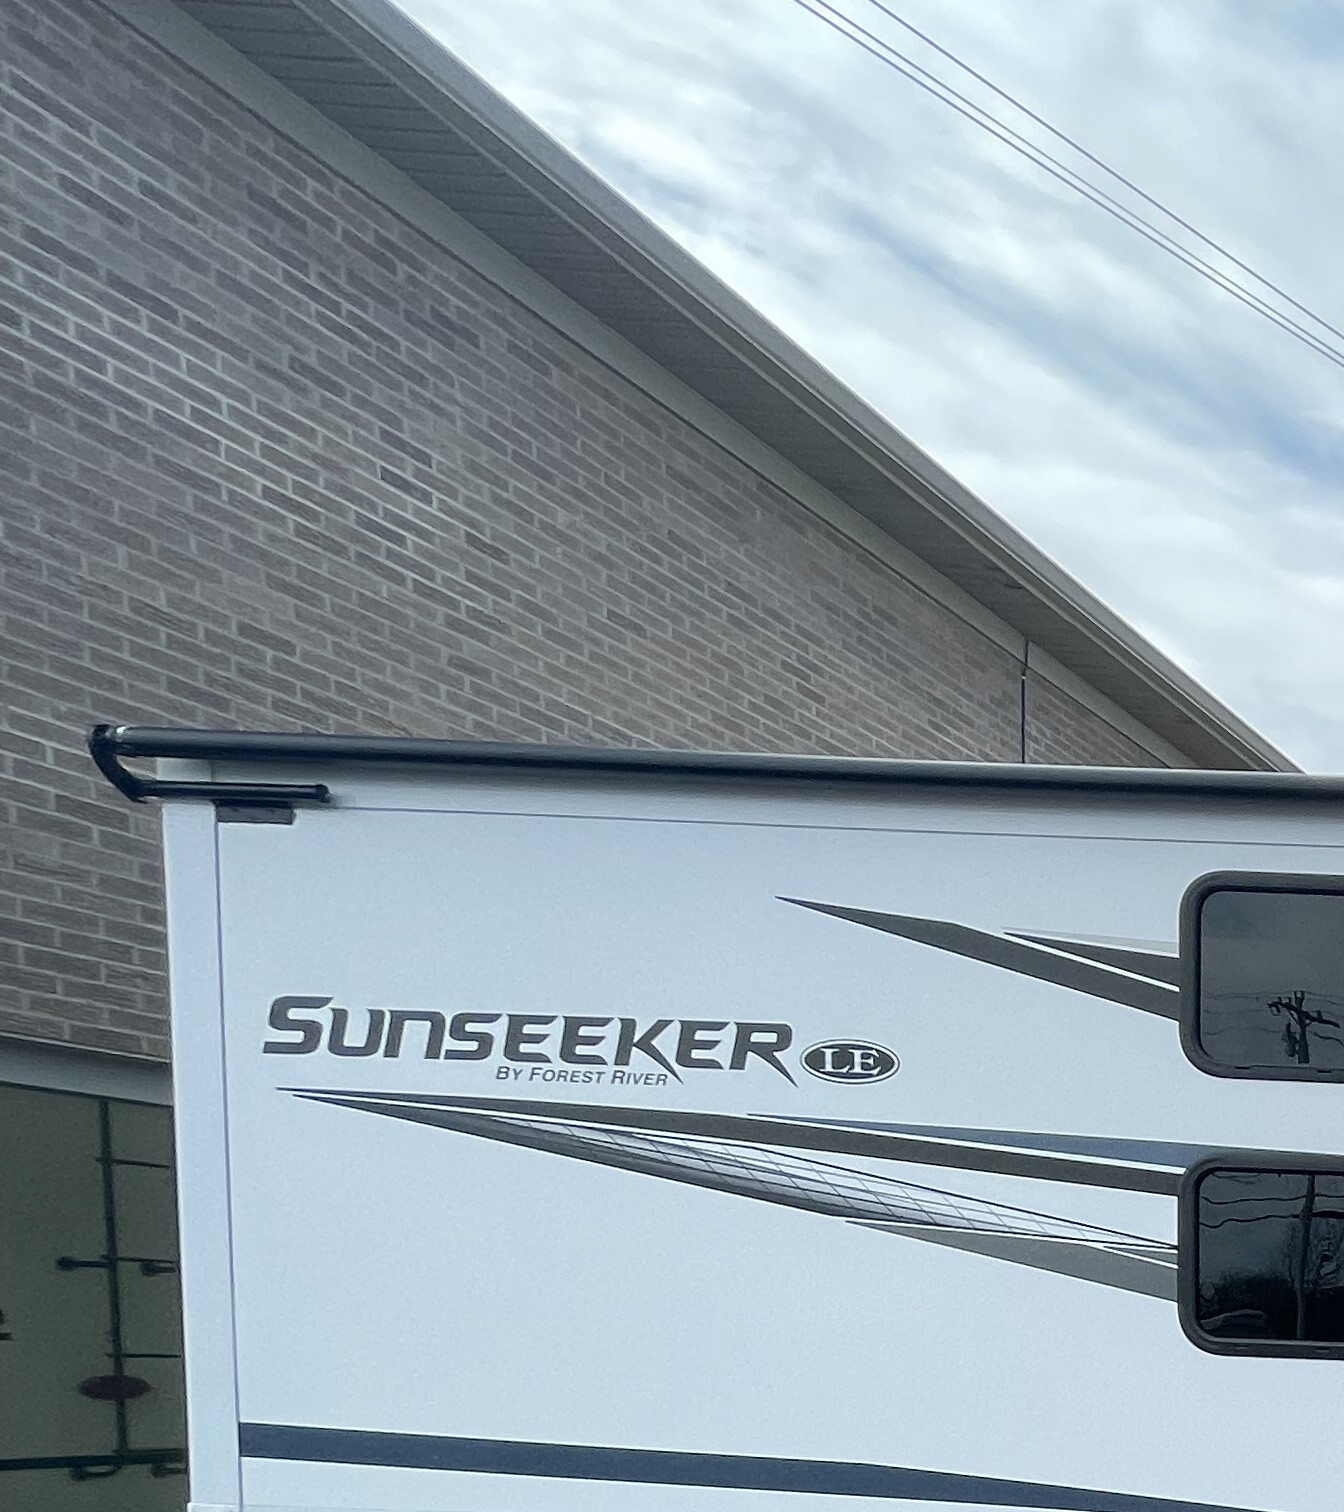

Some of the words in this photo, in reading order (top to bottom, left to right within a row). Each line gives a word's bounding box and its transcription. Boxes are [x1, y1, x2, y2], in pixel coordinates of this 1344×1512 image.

[819, 1047, 882, 1076] LE
[495, 1065, 523, 1081] BY
[528, 1067, 606, 1084] FOREST
[610, 1069, 669, 1087] RIVER
